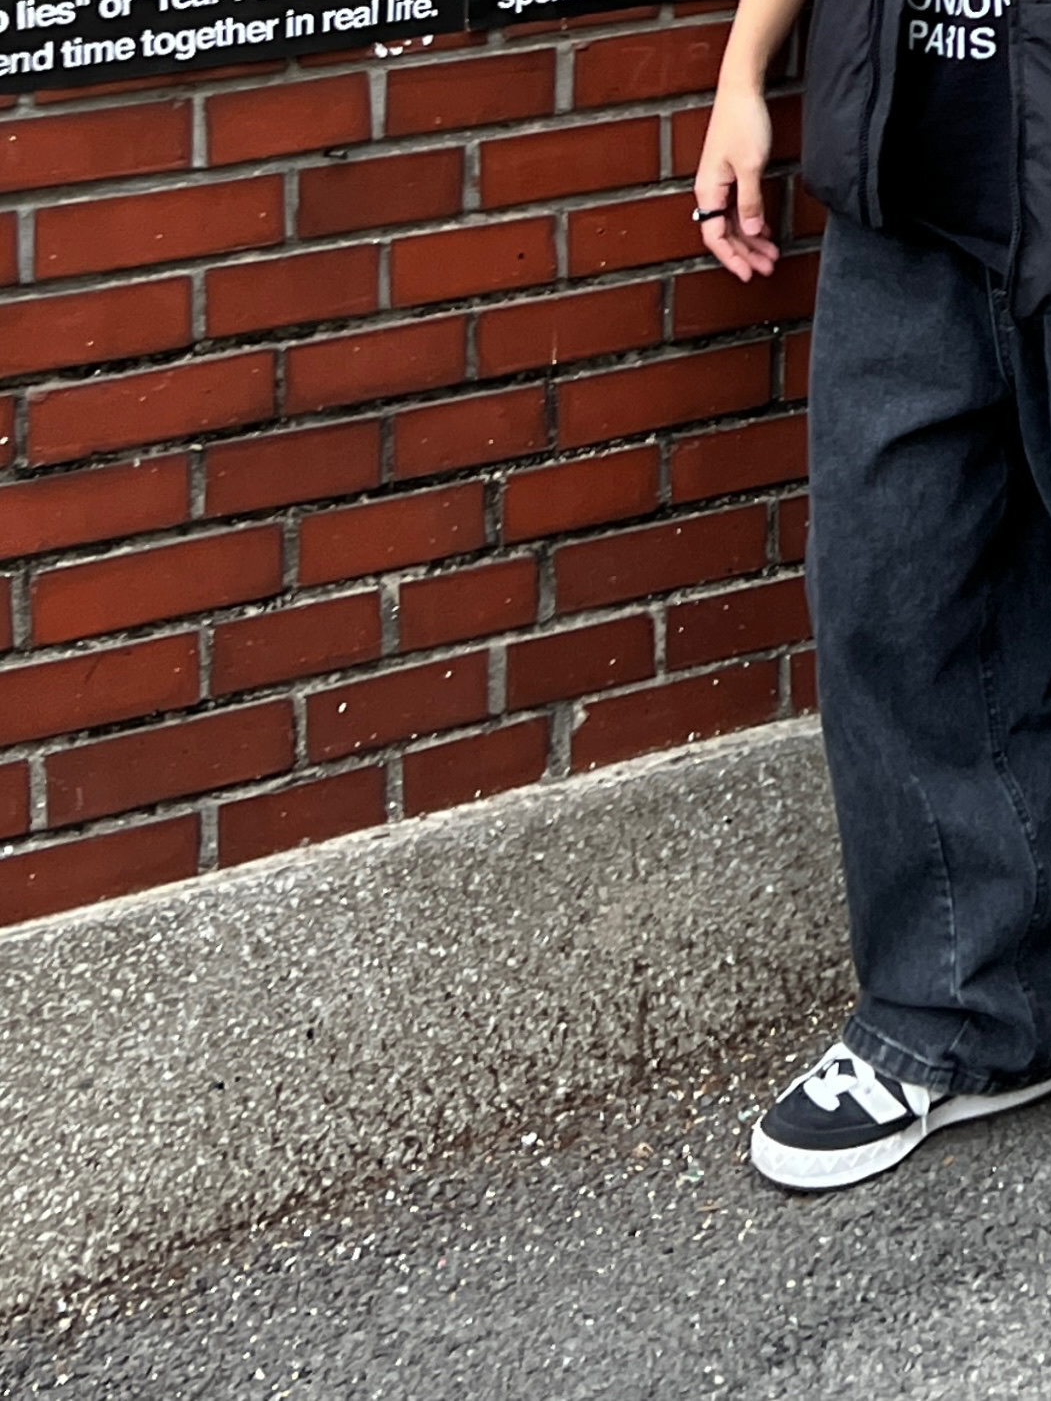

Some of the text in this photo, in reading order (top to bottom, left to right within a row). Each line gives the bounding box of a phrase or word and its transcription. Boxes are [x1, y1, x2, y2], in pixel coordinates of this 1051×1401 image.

[59, 36, 137, 68] time
[139, 17, 280, 61] together
[285, 8, 315, 39] in
